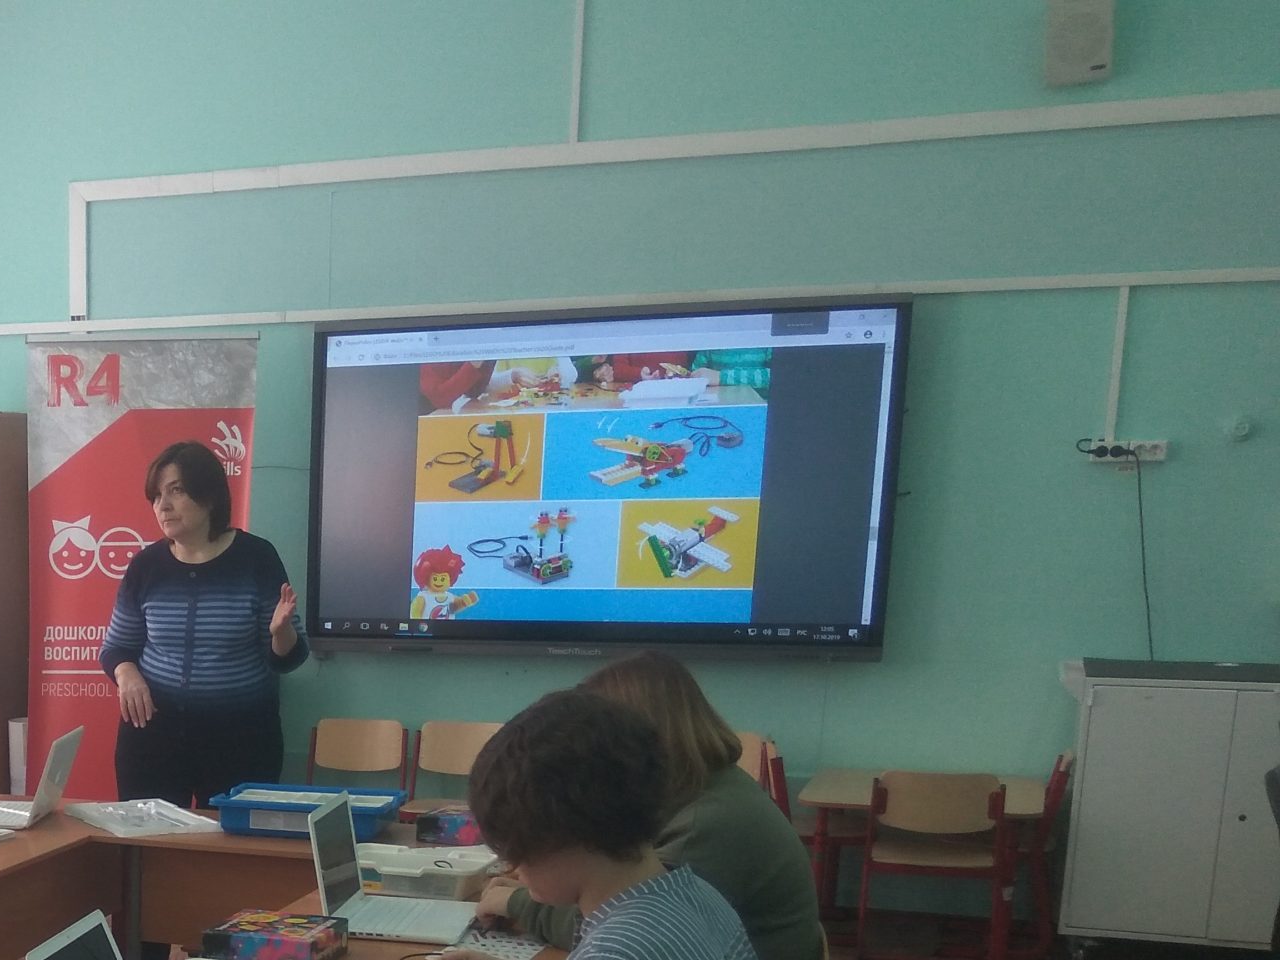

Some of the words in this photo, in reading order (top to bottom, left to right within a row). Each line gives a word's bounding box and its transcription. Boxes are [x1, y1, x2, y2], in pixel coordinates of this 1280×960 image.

[47, 352, 121, 407] R4
[44, 626, 108, 642] ДОШКОЛ
[44, 646, 99, 661] ВОСПИТ
[41, 682, 113, 697] PRESCHOOL
